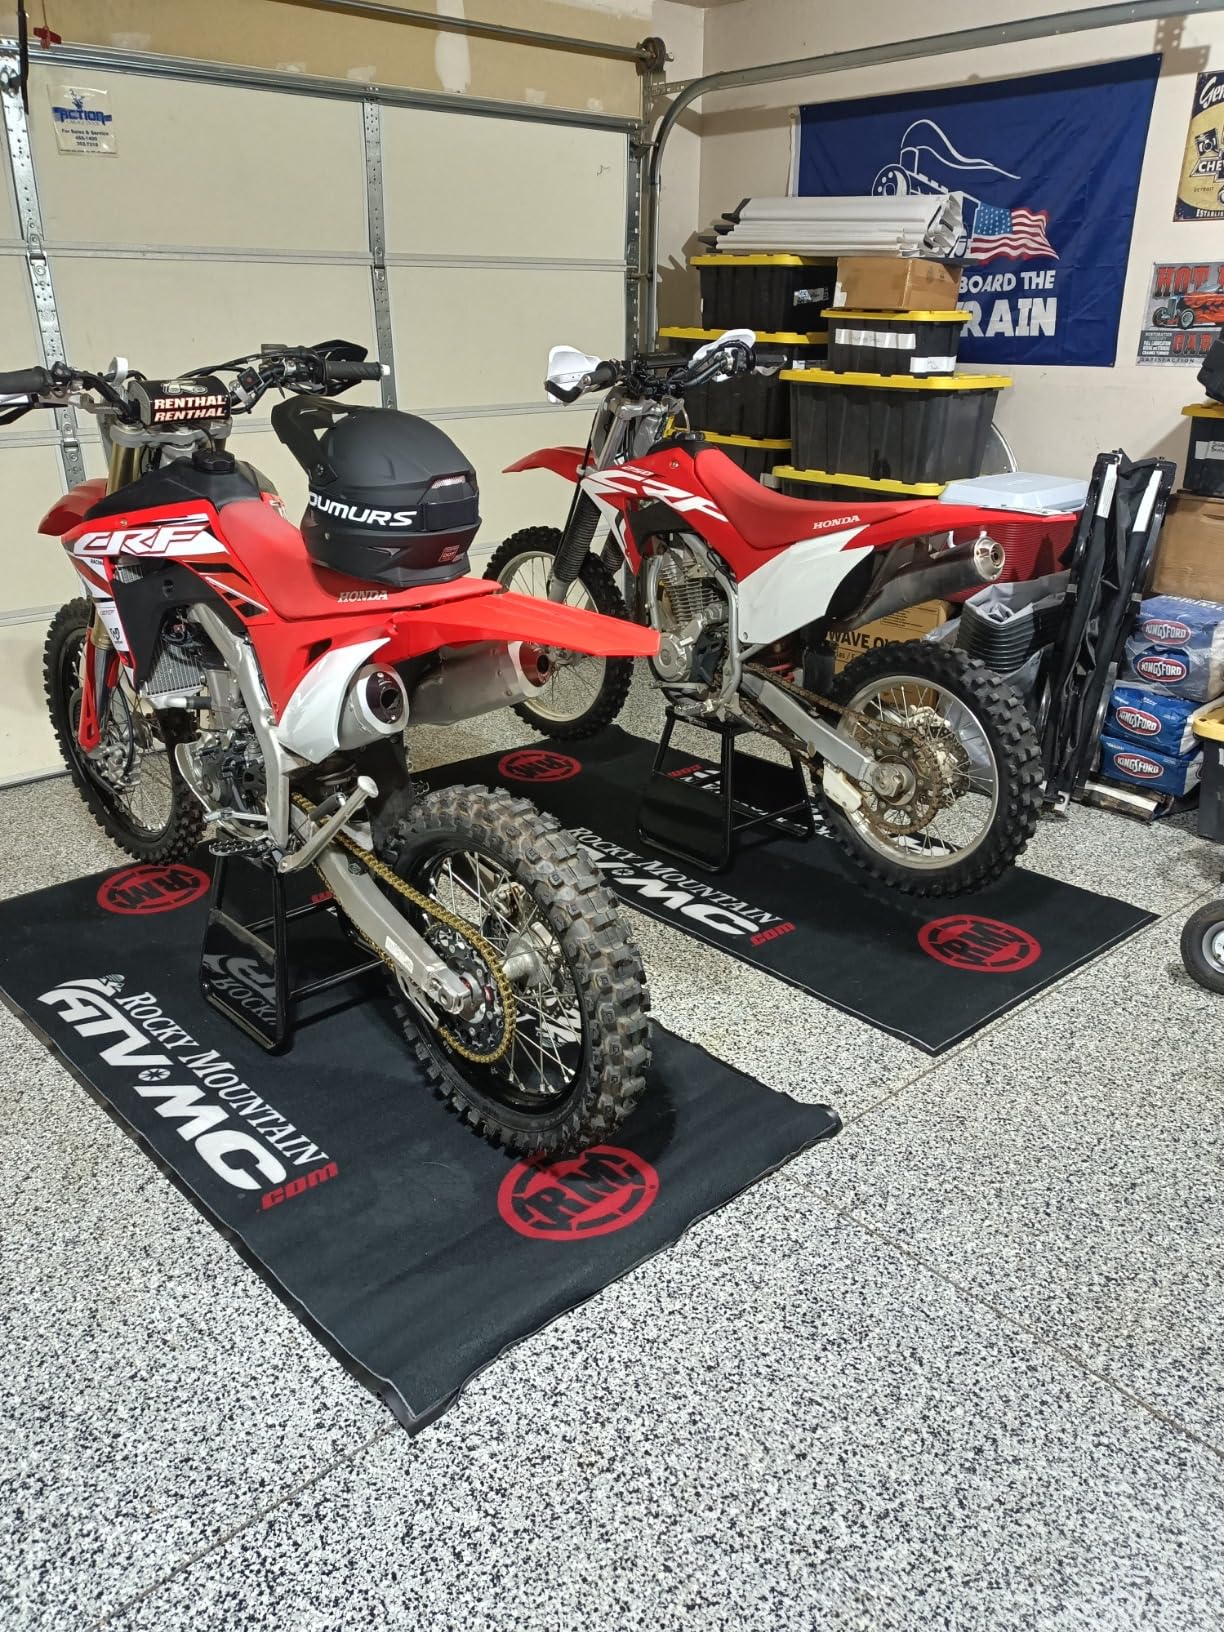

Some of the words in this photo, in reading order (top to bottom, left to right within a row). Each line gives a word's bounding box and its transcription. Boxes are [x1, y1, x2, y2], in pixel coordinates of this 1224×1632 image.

[1198, 160, 1224, 173] CHE
[1020, 270, 1056, 290] THE
[1154, 265, 1210, 297] HOT
[956, 297, 1057, 338] RAIN
[154, 395, 226, 410] RENTHAL
[153, 408, 225, 422] RENTHAL
[812, 514, 861, 530] HONDA
[73, 524, 210, 556] CRF
[337, 590, 389, 603] HONDA
[1145, 621, 1187, 640] KINGSFORD
[1141, 660, 1183, 679] KINGSFORD
[1119, 711, 1157, 731] KINGSFORD
[1117, 757, 1159, 774] KINGSFORD
[567, 826, 643, 862] ROCKY
[634, 859, 784, 924] MOUNTAIN
[114, 991, 201, 1050] ROCKY
[177, 1049, 330, 1167] MOUNTAIN
